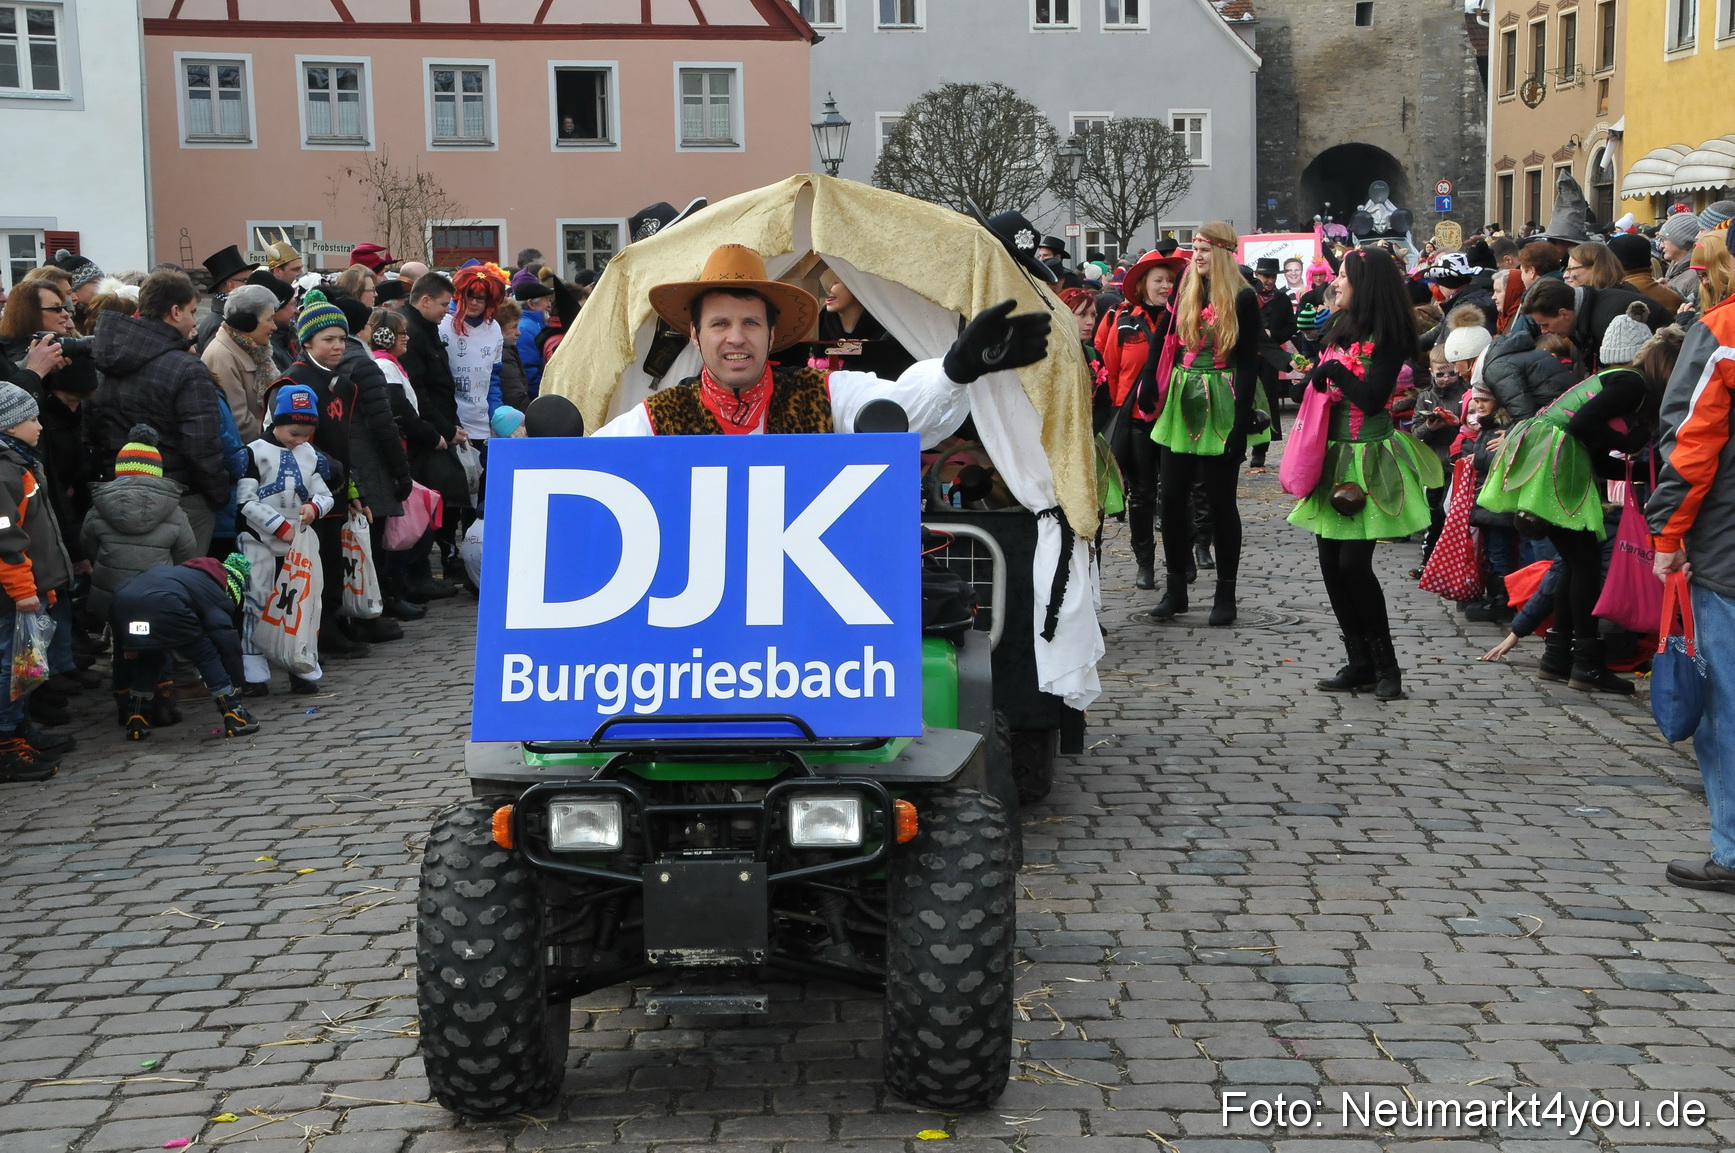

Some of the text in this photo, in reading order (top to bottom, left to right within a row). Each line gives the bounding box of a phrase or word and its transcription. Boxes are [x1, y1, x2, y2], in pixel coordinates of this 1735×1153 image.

[313, 243, 356, 253] Probststraß
[1246, 241, 1290, 268] Karffelsack
[505, 464, 895, 630] DJK
[501, 645, 896, 715] Burggriesbach
